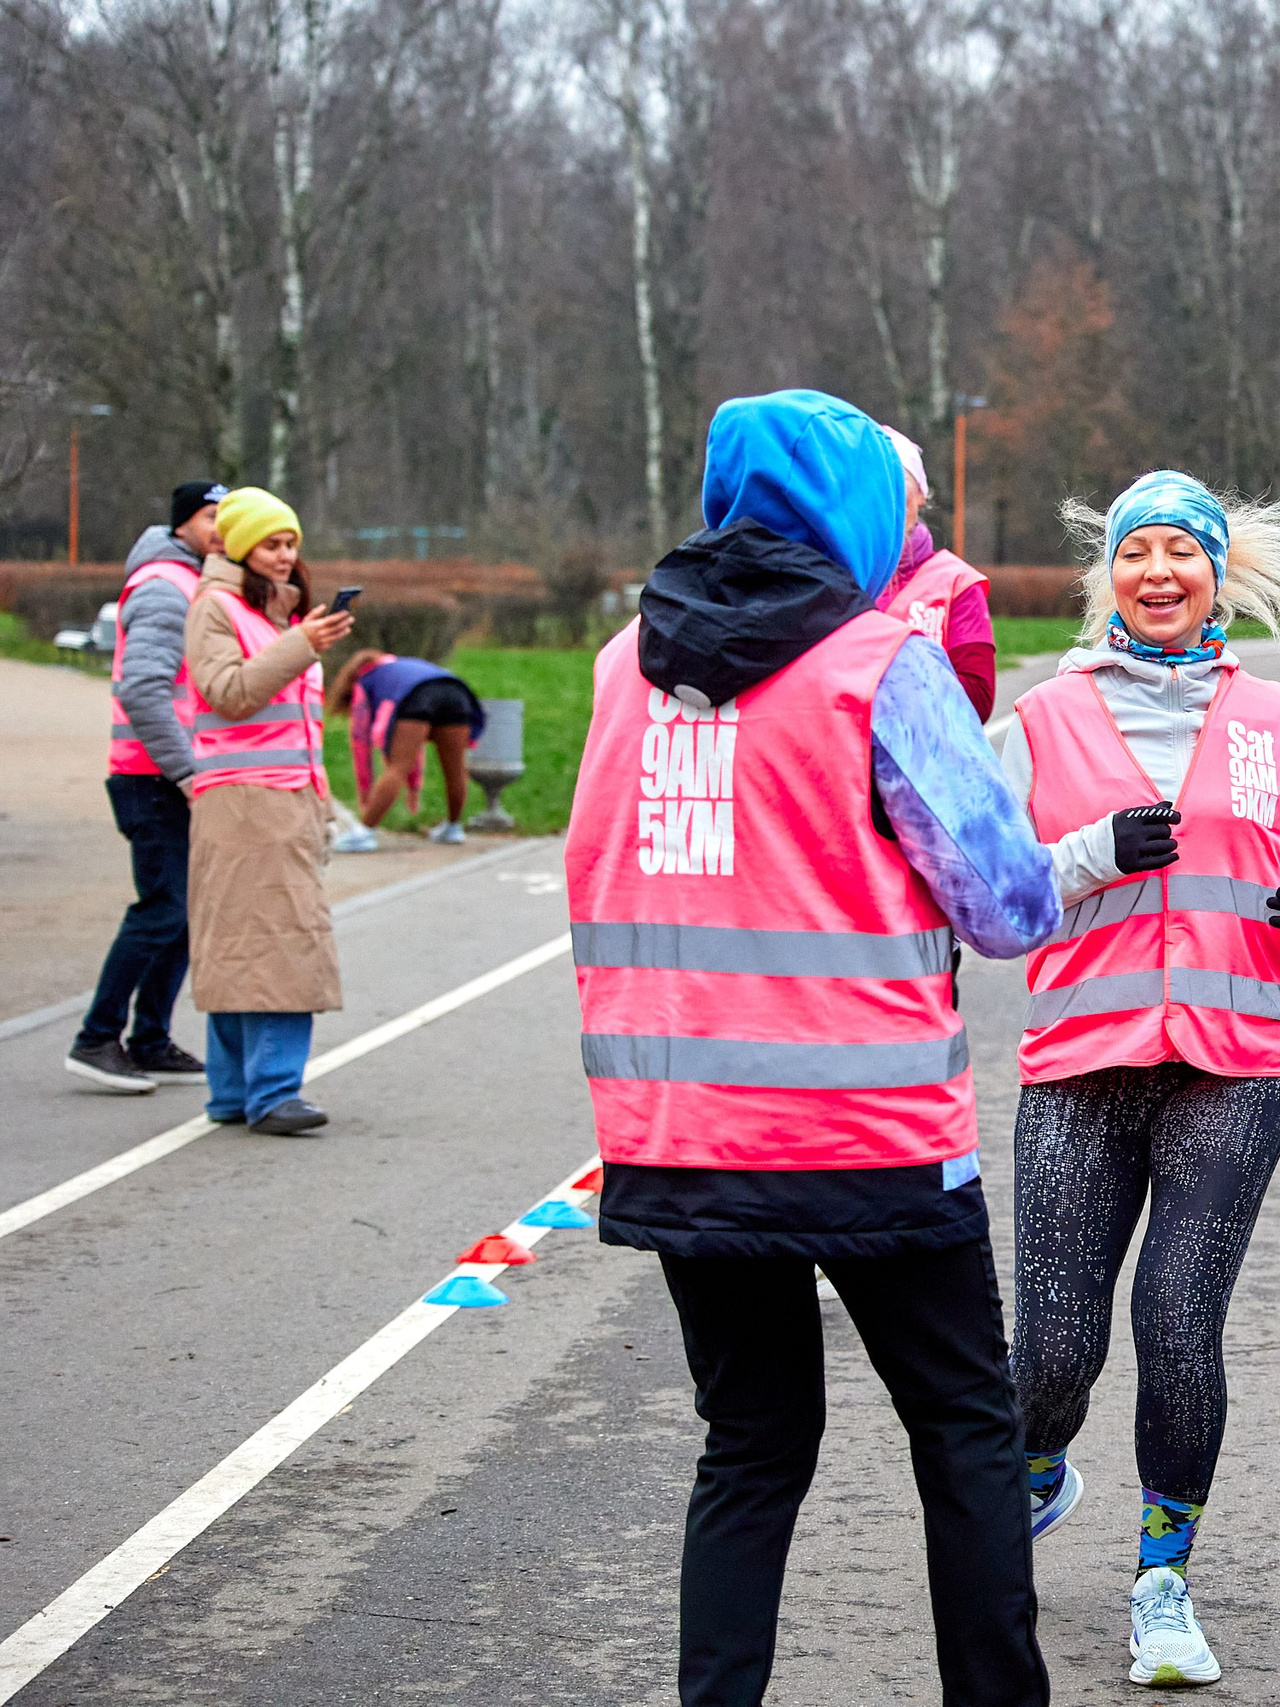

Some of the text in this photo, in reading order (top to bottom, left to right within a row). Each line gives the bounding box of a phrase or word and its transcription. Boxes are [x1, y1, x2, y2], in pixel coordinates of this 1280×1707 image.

[640, 723, 737, 799] 9AM
[1227, 720, 1276, 766] Sat
[1229, 757, 1279, 795] 9AM
[1230, 786, 1279, 829] 5KM
[638, 800, 735, 876] 5KM
